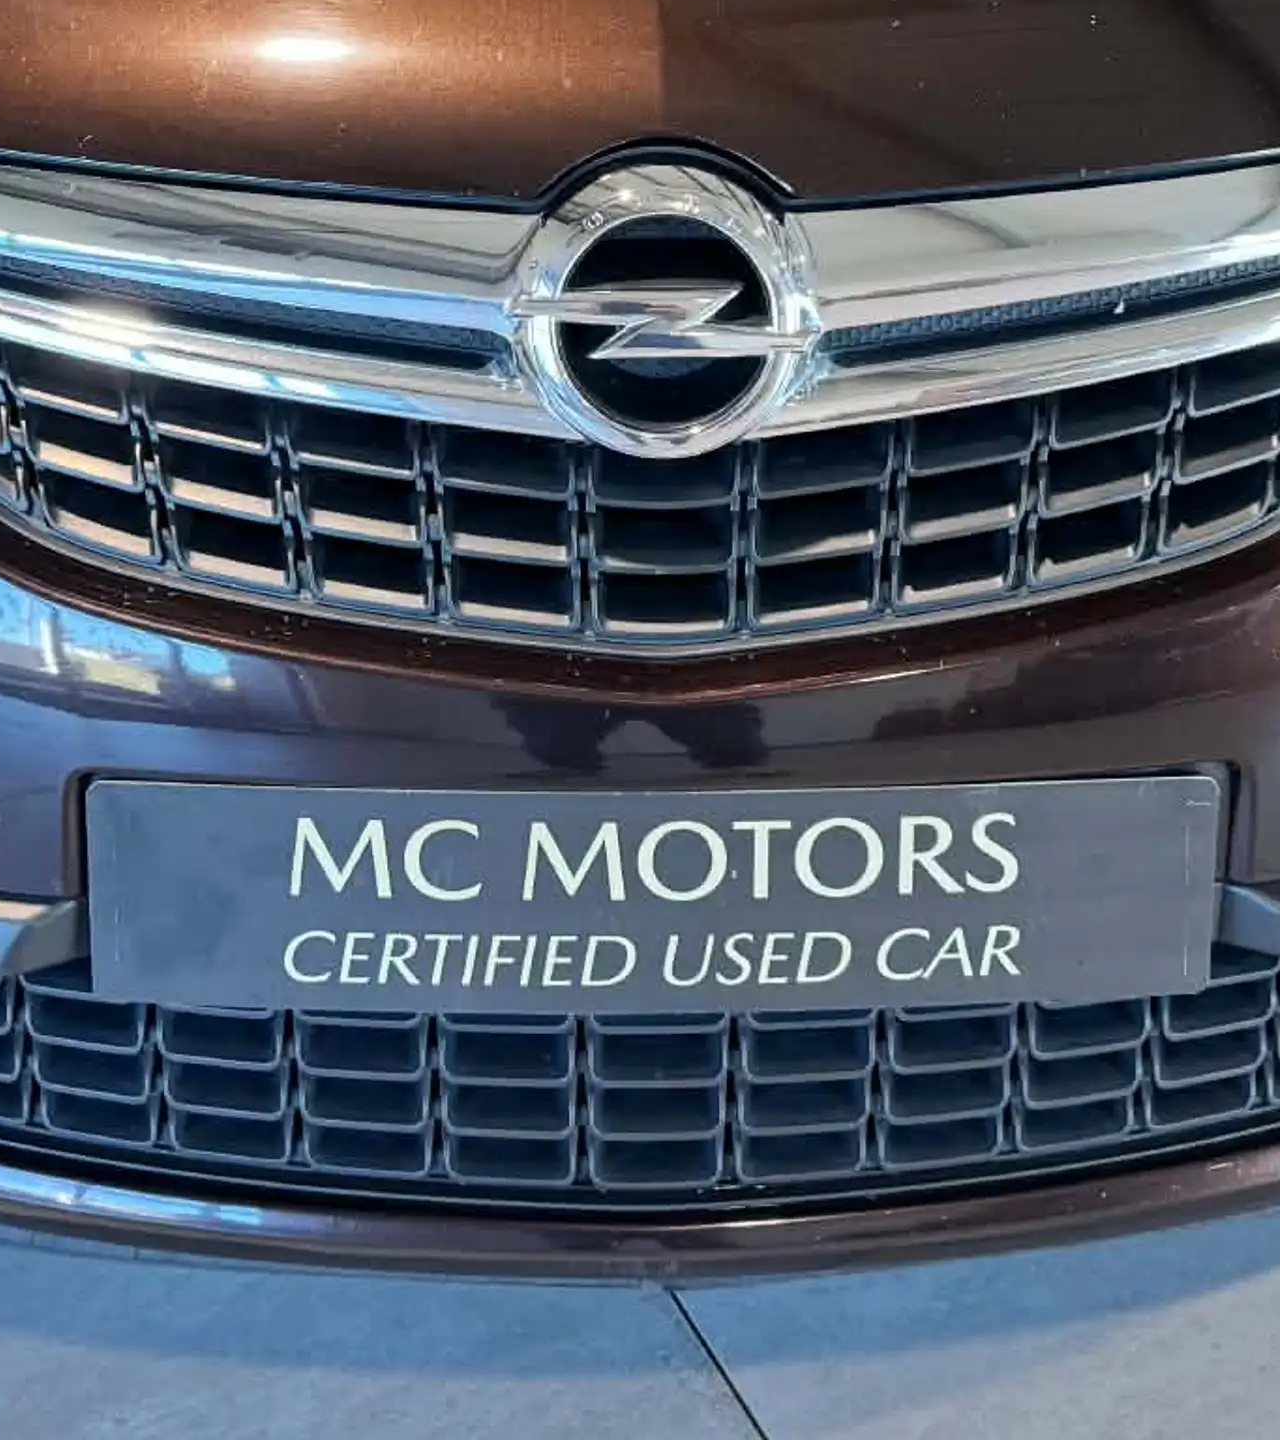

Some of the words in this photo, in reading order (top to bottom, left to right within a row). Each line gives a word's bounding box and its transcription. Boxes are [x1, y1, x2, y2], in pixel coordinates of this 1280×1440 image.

[290, 817, 482, 901] MC
[522, 812, 1020, 902] MOTORS
[283, 930, 636, 987] CERTIFIED
[663, 931, 852, 987] USED
[876, 924, 1022, 981] CAR
